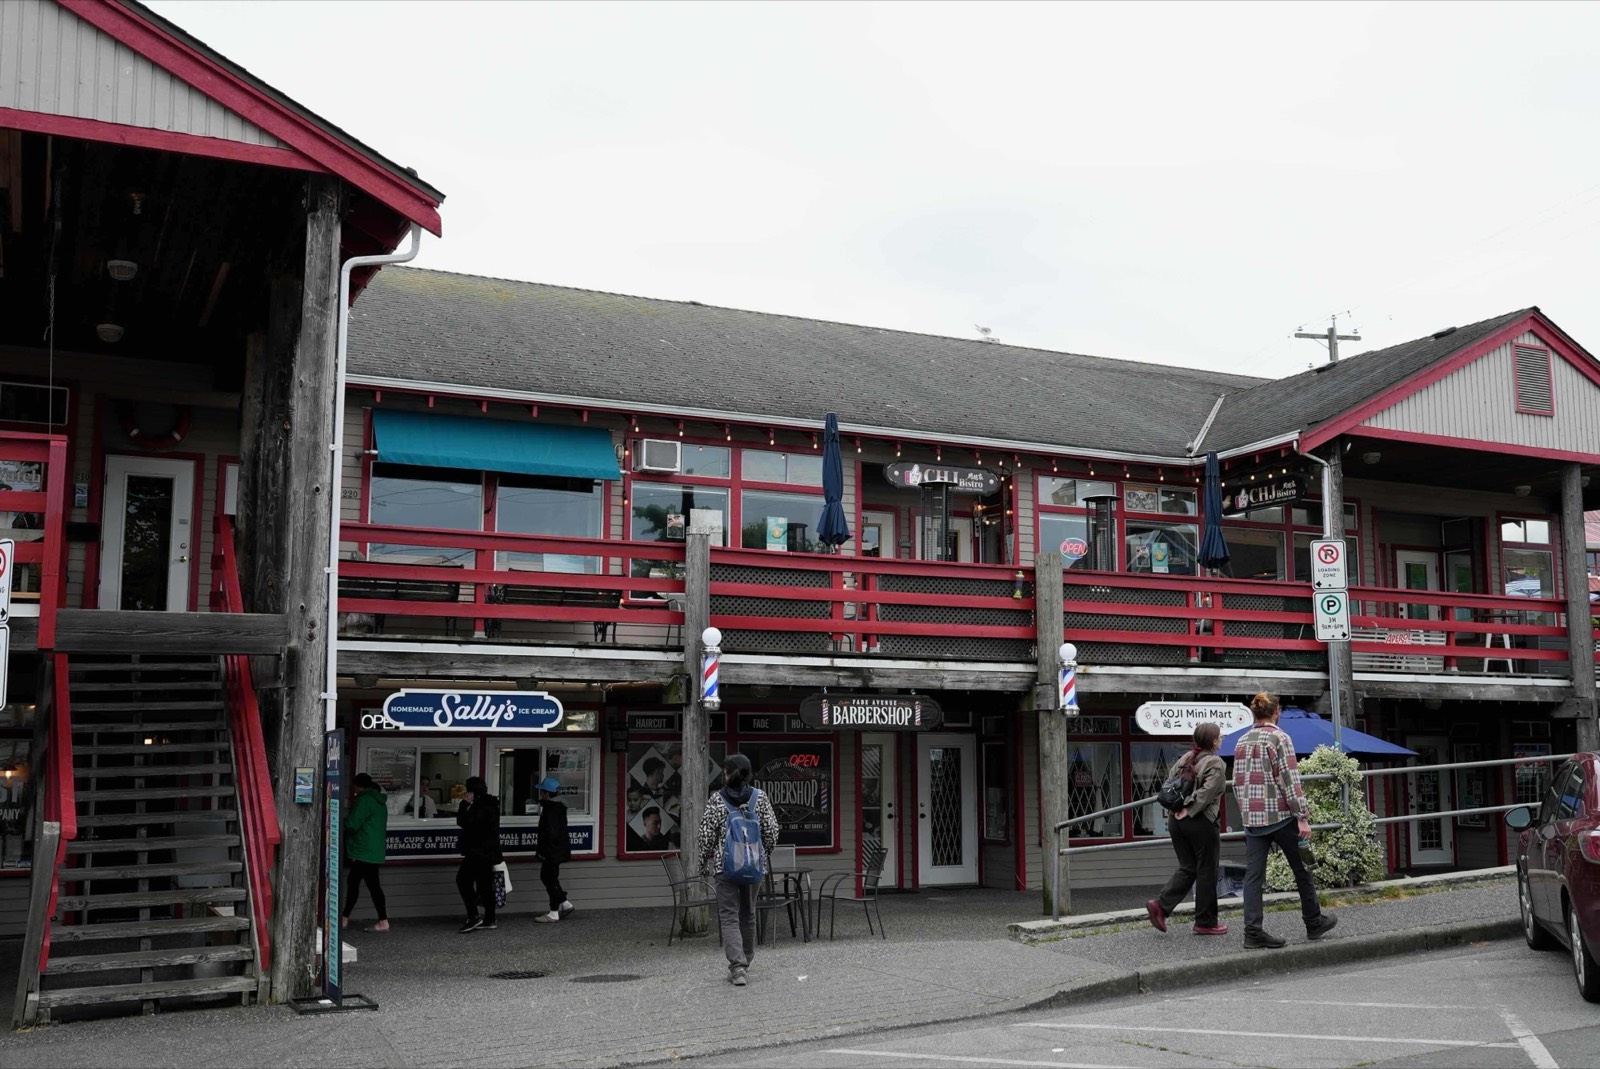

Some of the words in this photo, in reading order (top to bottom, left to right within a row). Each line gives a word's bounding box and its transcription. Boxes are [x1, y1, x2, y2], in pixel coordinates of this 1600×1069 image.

[959, 478, 984, 489] Bistro
[342, 489, 359, 499] 220
[1250, 484, 1277, 503] CHJ
[1061, 542, 1086, 555] OPEN
[872, 699, 898, 707] AVENUE
[390, 706, 435, 714] HOMEMADE
[433, 693, 518, 728] Sally's
[832, 704, 914, 726] BARBERSHOP
[1160, 709, 1184, 719] KOJI
[1186, 708, 1208, 719] Mini
[1209, 708, 1232, 719] Mart
[361, 714, 395, 730] OPE
[635, 718, 668, 729] HAIRCUT
[752, 718, 769, 729] FADE
[788, 753, 820, 768] OPEN
[404, 836, 425, 844] CUPS
[435, 835, 459, 843] PINTS
[439, 841, 457, 849] SITE
